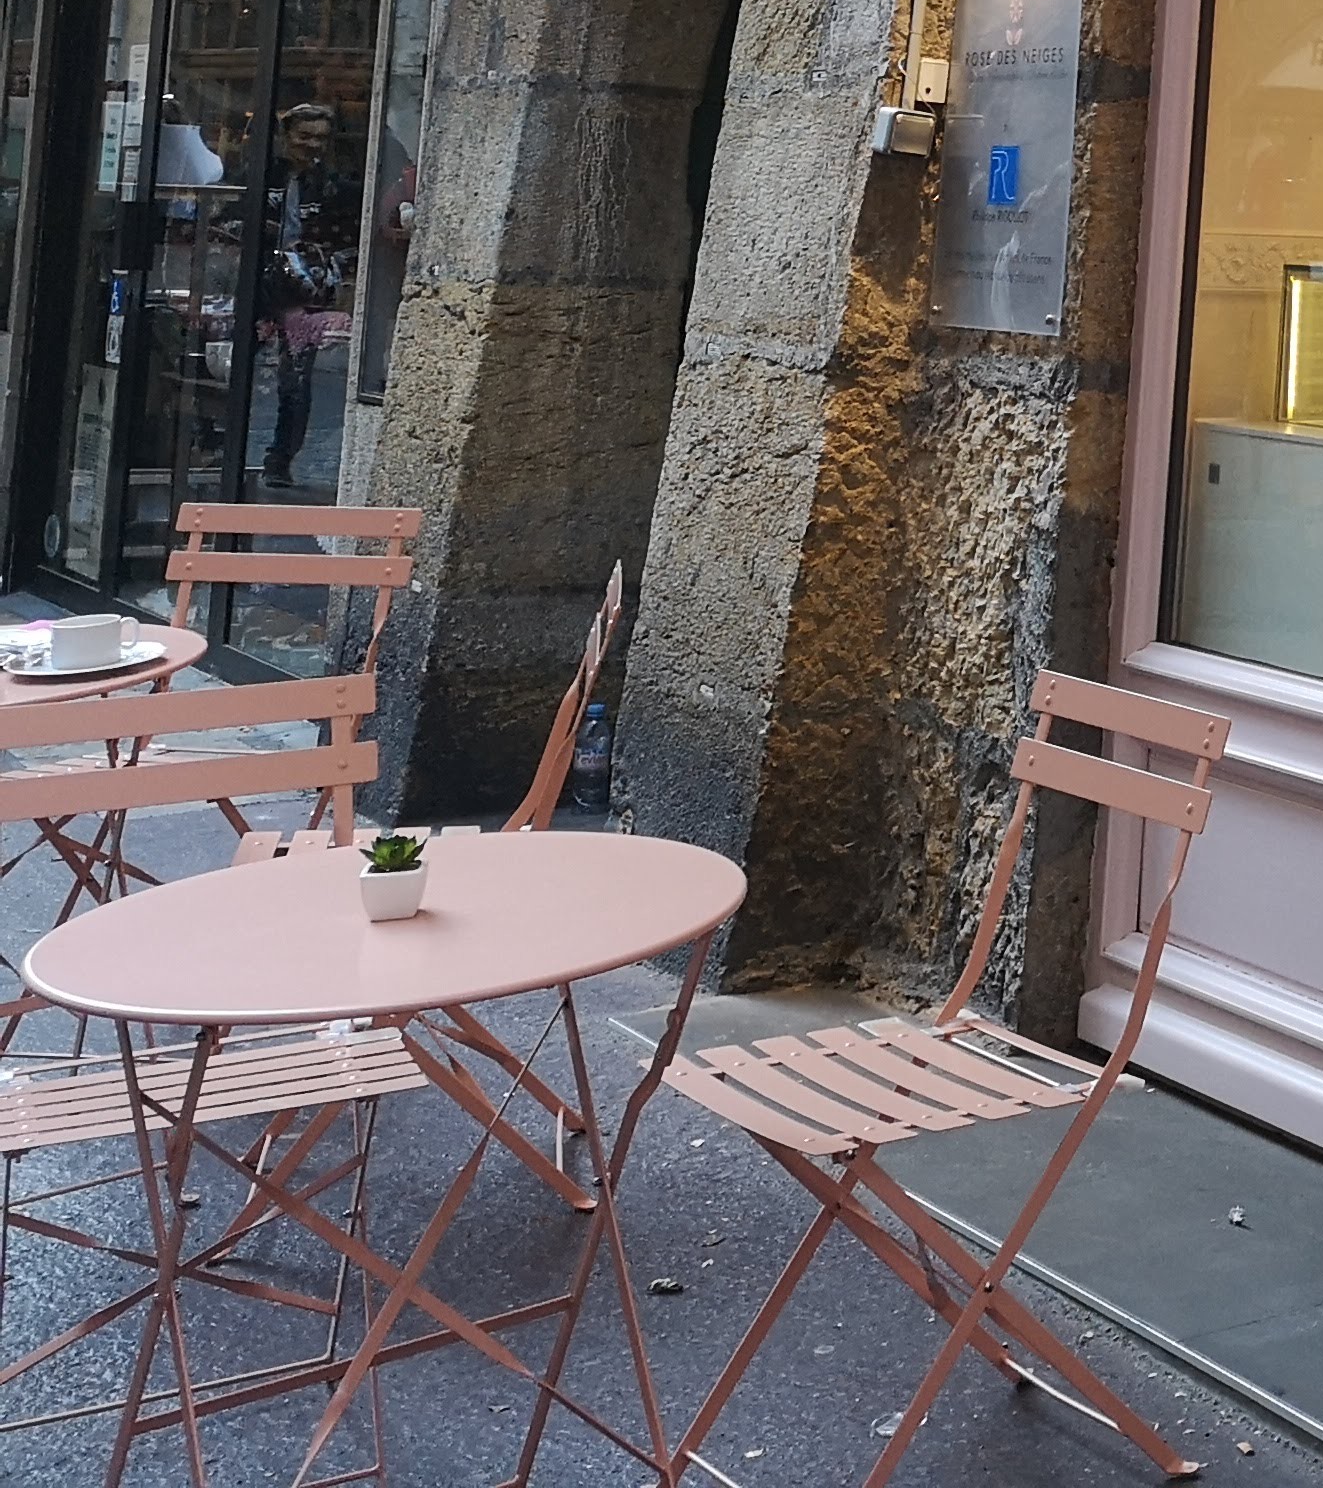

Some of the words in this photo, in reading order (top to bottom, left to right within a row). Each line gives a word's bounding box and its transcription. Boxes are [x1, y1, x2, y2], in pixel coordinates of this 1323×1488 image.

[965, 51, 992, 68] ROSE
[997, 49, 1017, 66] DES
[1023, 46, 1065, 64] NEIGES
